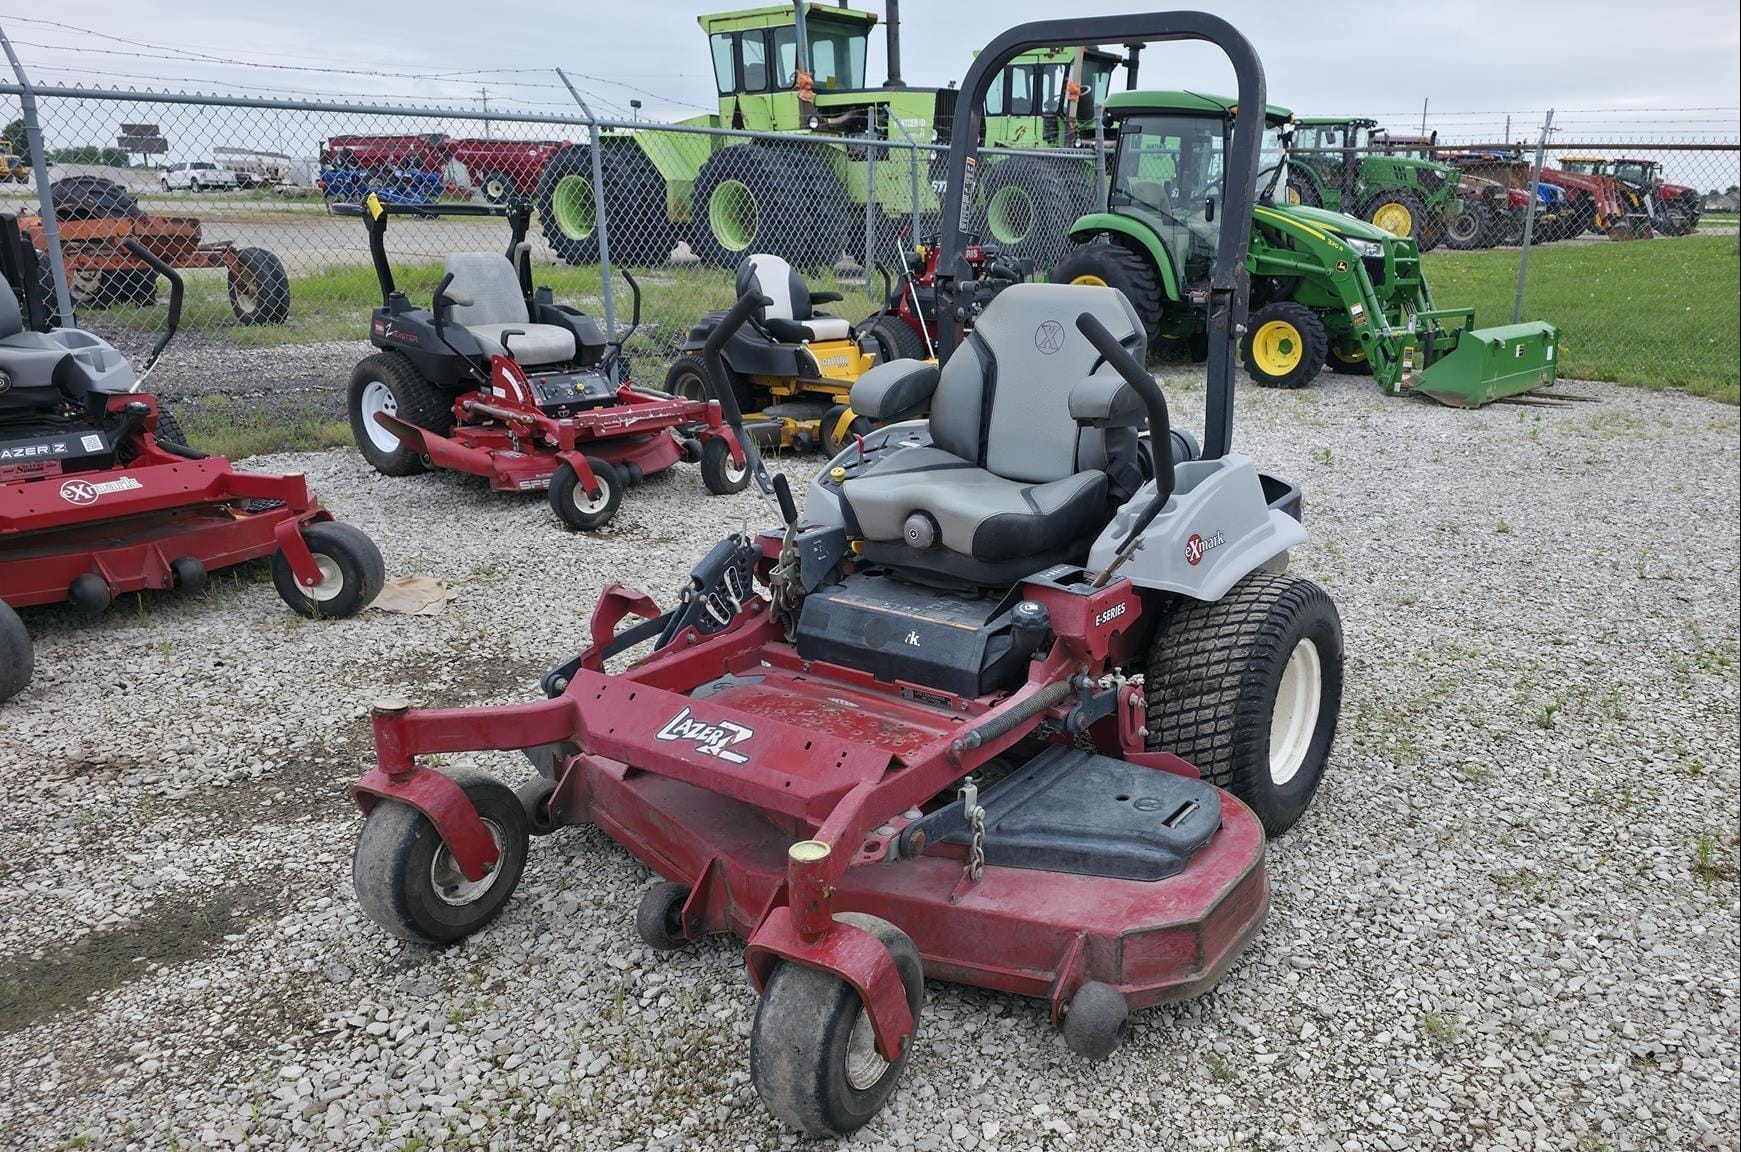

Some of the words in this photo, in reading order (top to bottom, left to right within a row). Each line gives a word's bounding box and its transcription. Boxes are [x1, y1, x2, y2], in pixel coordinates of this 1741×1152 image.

[61, 477, 142, 504] eXmark
[1185, 530, 1226, 563] eXmark
[1095, 602, 1127, 627] E-SERIES
[656, 705, 725, 746] LAZER
[695, 720, 755, 765] Z
